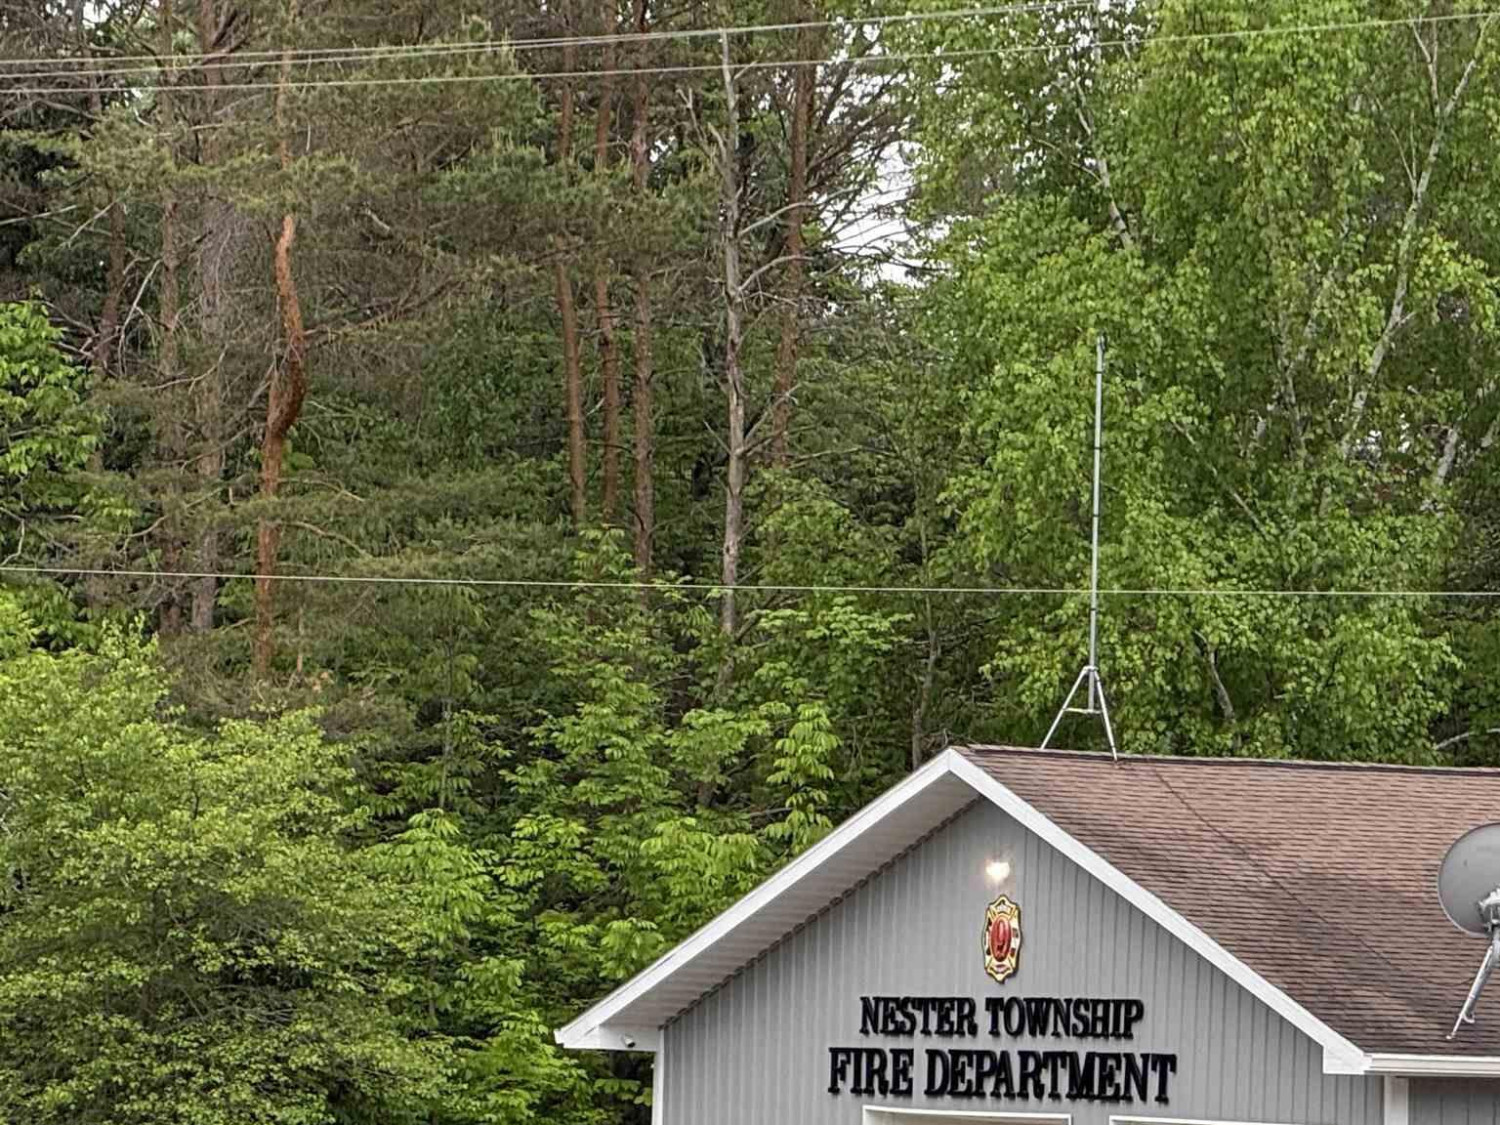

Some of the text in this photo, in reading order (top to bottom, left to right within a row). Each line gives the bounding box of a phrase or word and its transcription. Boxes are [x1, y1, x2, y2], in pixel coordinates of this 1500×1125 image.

[859, 996, 1144, 1039] NESTER TOWNSHIP
[828, 1047, 1177, 1103] FIRE DEPARTMENT
